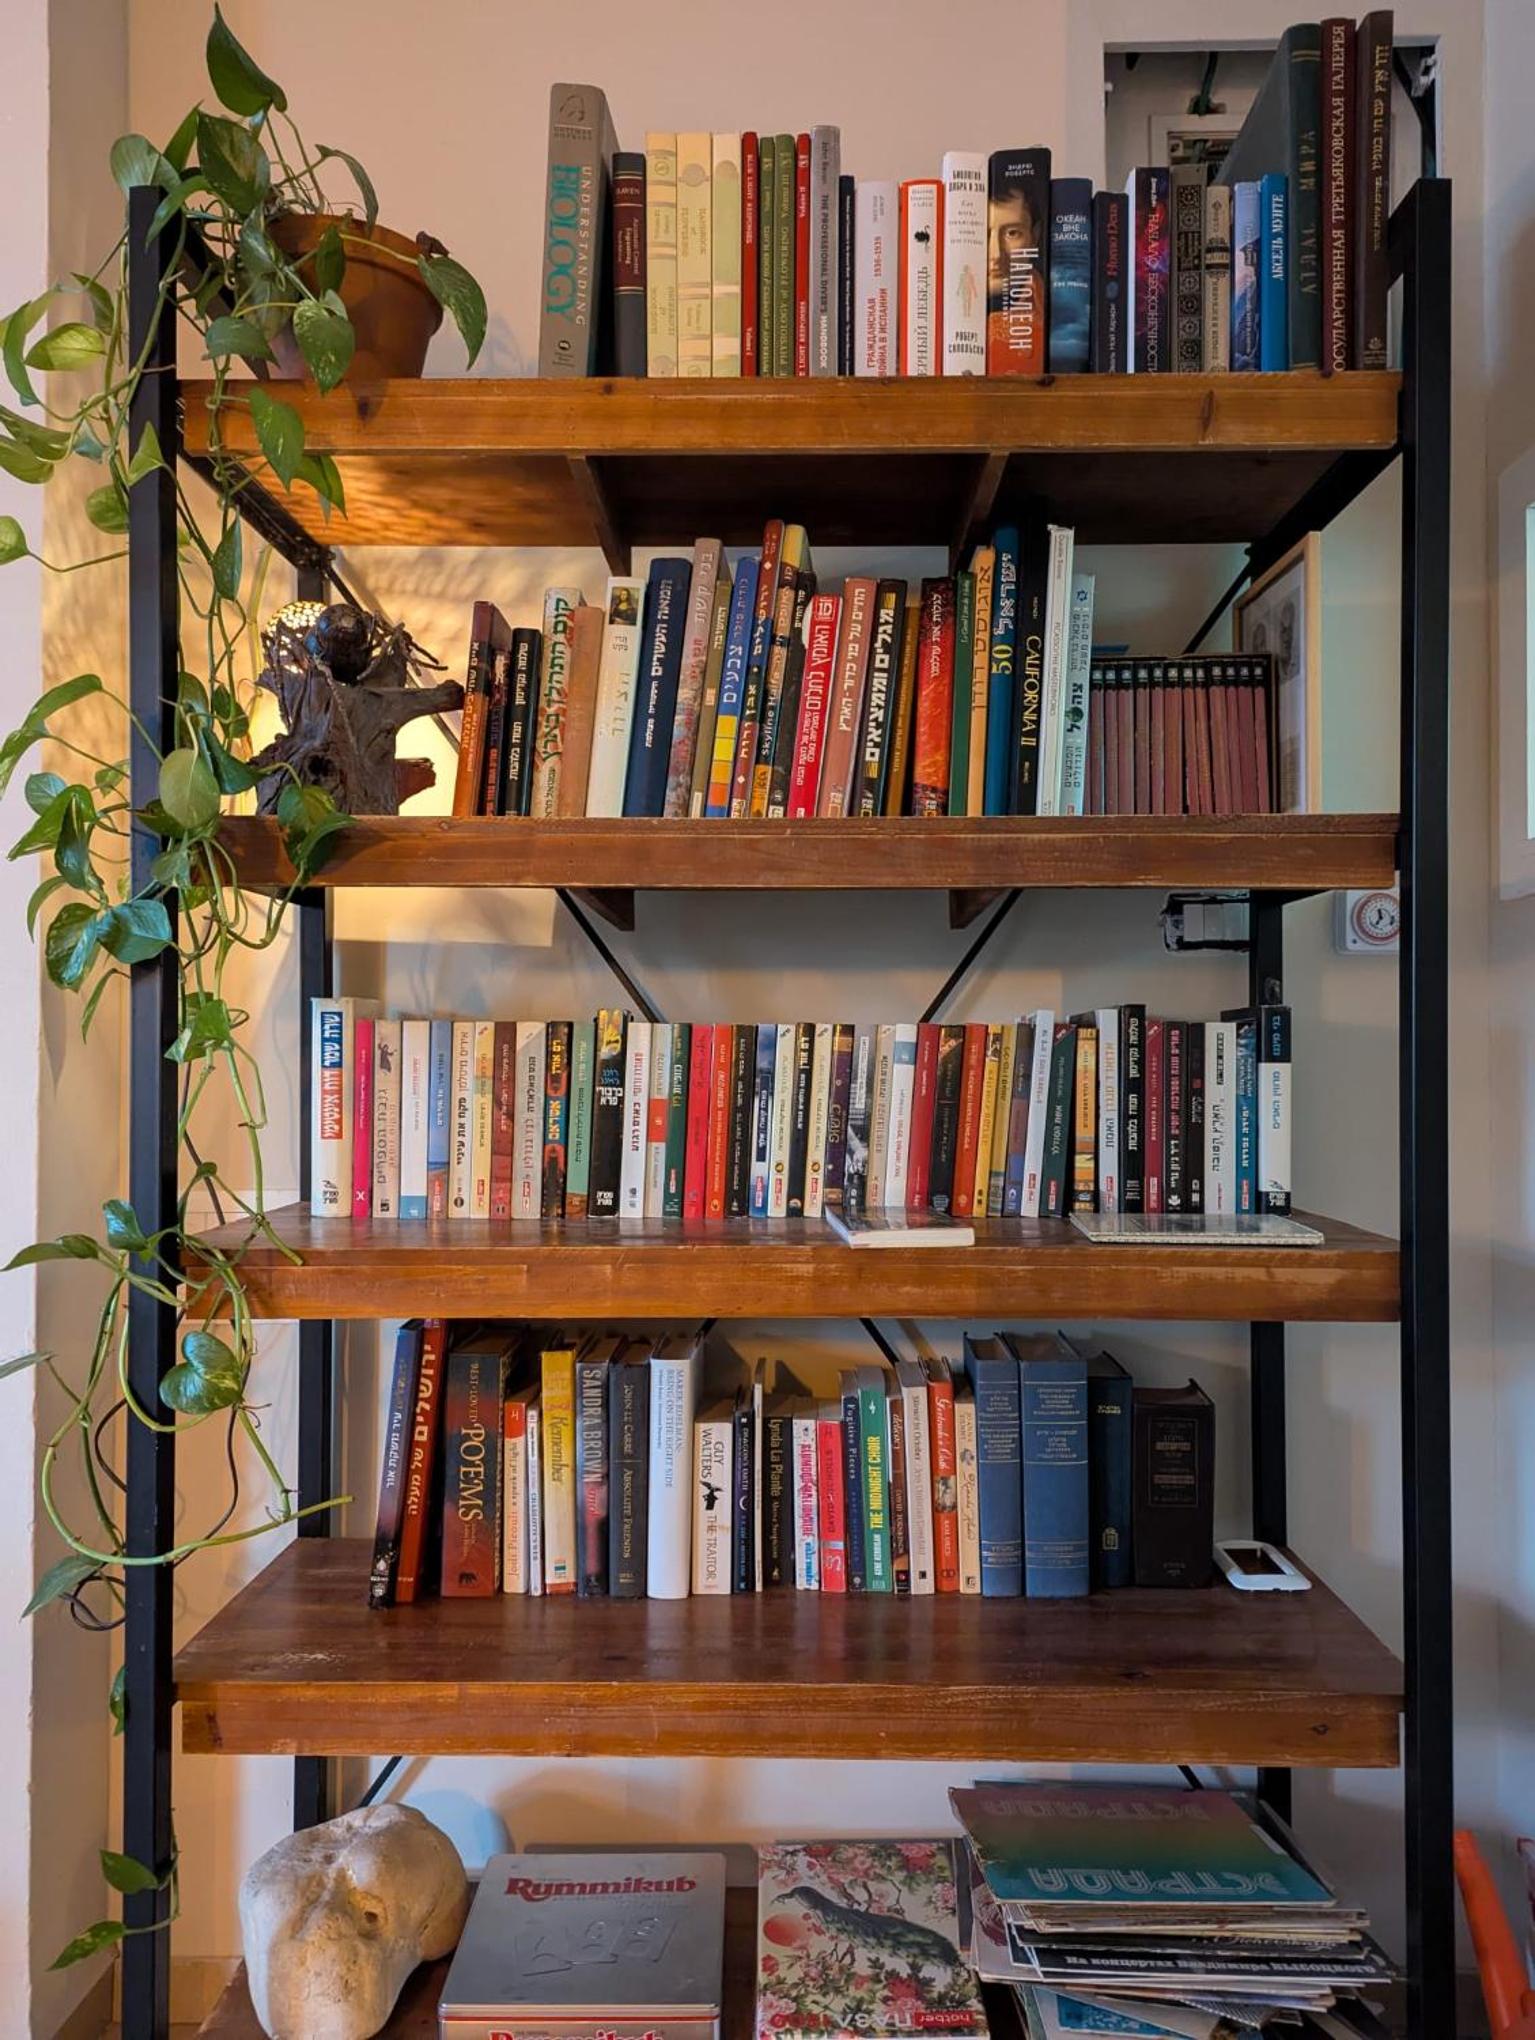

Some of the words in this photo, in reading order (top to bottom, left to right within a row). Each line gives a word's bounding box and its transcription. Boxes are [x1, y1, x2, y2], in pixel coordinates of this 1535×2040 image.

[1332, 25, 1345, 90] ГАЛЕРЕЯ
[1300, 130, 1317, 192] МИРА
[1332, 97, 1346, 224] ТРЕТЬЯКОВСКАЯ
[820, 194, 829, 211] THE
[949, 182, 967, 192] ДОБРА
[1056, 215, 1086, 224] ОКЕАН
[1063, 224, 1081, 232] ВНЕ
[1107, 203, 1119, 235] Deus
[1272, 194, 1284, 233] МУНТЕ
[545, 164, 581, 320] BIOLOGY
[576, 166, 592, 326] UNDERSTANDING
[781, 226, 789, 285] FLOWERING
[820, 213, 829, 279] PROFESSIONAL
[1054, 232, 1088, 241] ЗАКОНА
[1148, 214, 1159, 267] НАЧАЛО
[1107, 237, 1120, 277] Homo
[1272, 237, 1284, 280] АКСЕЛЬ
[1299, 221, 1318, 294] АТЛАС
[879, 288, 888, 333] ИСПАНИИ
[917, 266, 930, 321] ЛЕБЕДЬ
[1009, 248, 1039, 349] НАПОЛЕОН
[1332, 230, 1347, 371] ОСУДАРСТВЕННАЯ
[781, 303, 789, 364] PHYSIOLOGY
[820, 315, 828, 369] HANDBOOK
[867, 298, 876, 368] ГРАЖДАНСКАЯ
[914, 325, 928, 376] ЕРНЫЙ
[955, 331, 978, 341] РОБЕРТ
[698, 552, 714, 576] בני
[658, 579, 672, 620] המאה
[694, 585, 712, 623] קשת
[852, 588, 866, 621] החיים
[930, 593, 942, 622] לגלות
[974, 565, 991, 653] אוגוסט
[992, 552, 1016, 636] ישראל
[553, 597, 575, 635] קום
[751, 585, 769, 656] ירושלים
[847, 624, 861, 640] על
[929, 625, 942, 641] את
[468, 641, 479, 666] איים
[516, 642, 528, 670] שלמה
[650, 623, 668, 677] העשרים
[811, 624, 832, 666] האומץ
[848, 643, 859, 659] פני
[874, 608, 895, 669] מגלים
[543, 641, 566, 708] התהלך
[722, 645, 742, 703] צבעים
[929, 645, 941, 677] עולמנו
[991, 645, 1014, 675] 50
[743, 684, 757, 716] אבן
[766, 671, 779, 706] Haifa
[805, 672, 826, 710] לחלום
[971, 666, 986, 710] רודן
[1021, 635, 1042, 731] CALIFORNIA
[761, 710, 776, 756] Skyline
[864, 672, 888, 762] וממציאים
[541, 713, 562, 761] בארץ
[739, 721, 753, 759] ורוח
[1021, 735, 1037, 747] II
[508, 747, 520, 780] בלהבות
[322, 1013, 337, 1038] שרה
[1128, 1018, 1138, 1044] שלמה
[323, 1042, 337, 1066] שמר
[528, 1056, 536, 1072] הנס
[552, 1040, 564, 1054] רם
[322, 1070, 337, 1090] דוח
[323, 1094, 338, 1137] אינטימי
[377, 1089, 387, 1122] גנבת
[548, 1100, 560, 1139] אשראם
[1211, 1104, 1222, 1133] הארץ
[1128, 1119, 1138, 1150] בלהבות
[377, 1128, 387, 1184] הספרים
[1211, 1138, 1220, 1172] הטובה
[414, 1344, 436, 1441] ירושלים
[582, 1370, 602, 1426] SANDRA
[623, 1385, 633, 1405] JOHN
[665, 1369, 674, 1398] BEING
[391, 1411, 402, 1430] עיר
[665, 1416, 674, 1435] THE
[666, 1400, 674, 1414] ON
[847, 1404, 857, 1444] Fugitive
[549, 1415, 570, 1483] Remember
[768, 1419, 783, 1447] Lynda
[867, 1436, 881, 1463] CHOIR
[913, 1432, 922, 1461] October
[411, 1448, 424, 1469] של
[582, 1430, 602, 1482] BROWN
[701, 1428, 712, 1479] WALTERS
[713, 1441, 724, 1465] GUY
[772, 1450, 783, 1463] La
[849, 1448, 858, 1479] Pieces
[385, 1470, 396, 1488] אור
[458, 1424, 485, 1522] POEMS
[665, 1466, 673, 1488] SIDE
[772, 1464, 783, 1496] Plante
[868, 1465, 882, 1510] MIDNIGHT
[407, 1474, 421, 1516] מעלה
[623, 1469, 633, 1516] ABSOLUTE
[507, 1512, 519, 1552] Picoult
[622, 1518, 633, 1558] FRIENDS
[707, 1515, 717, 1535] THE
[869, 1512, 883, 1529] THE
[706, 1537, 717, 1580] TRAITOR
[505, 1876, 697, 1902] Rummikub
[1065, 1956, 1086, 1966] На
